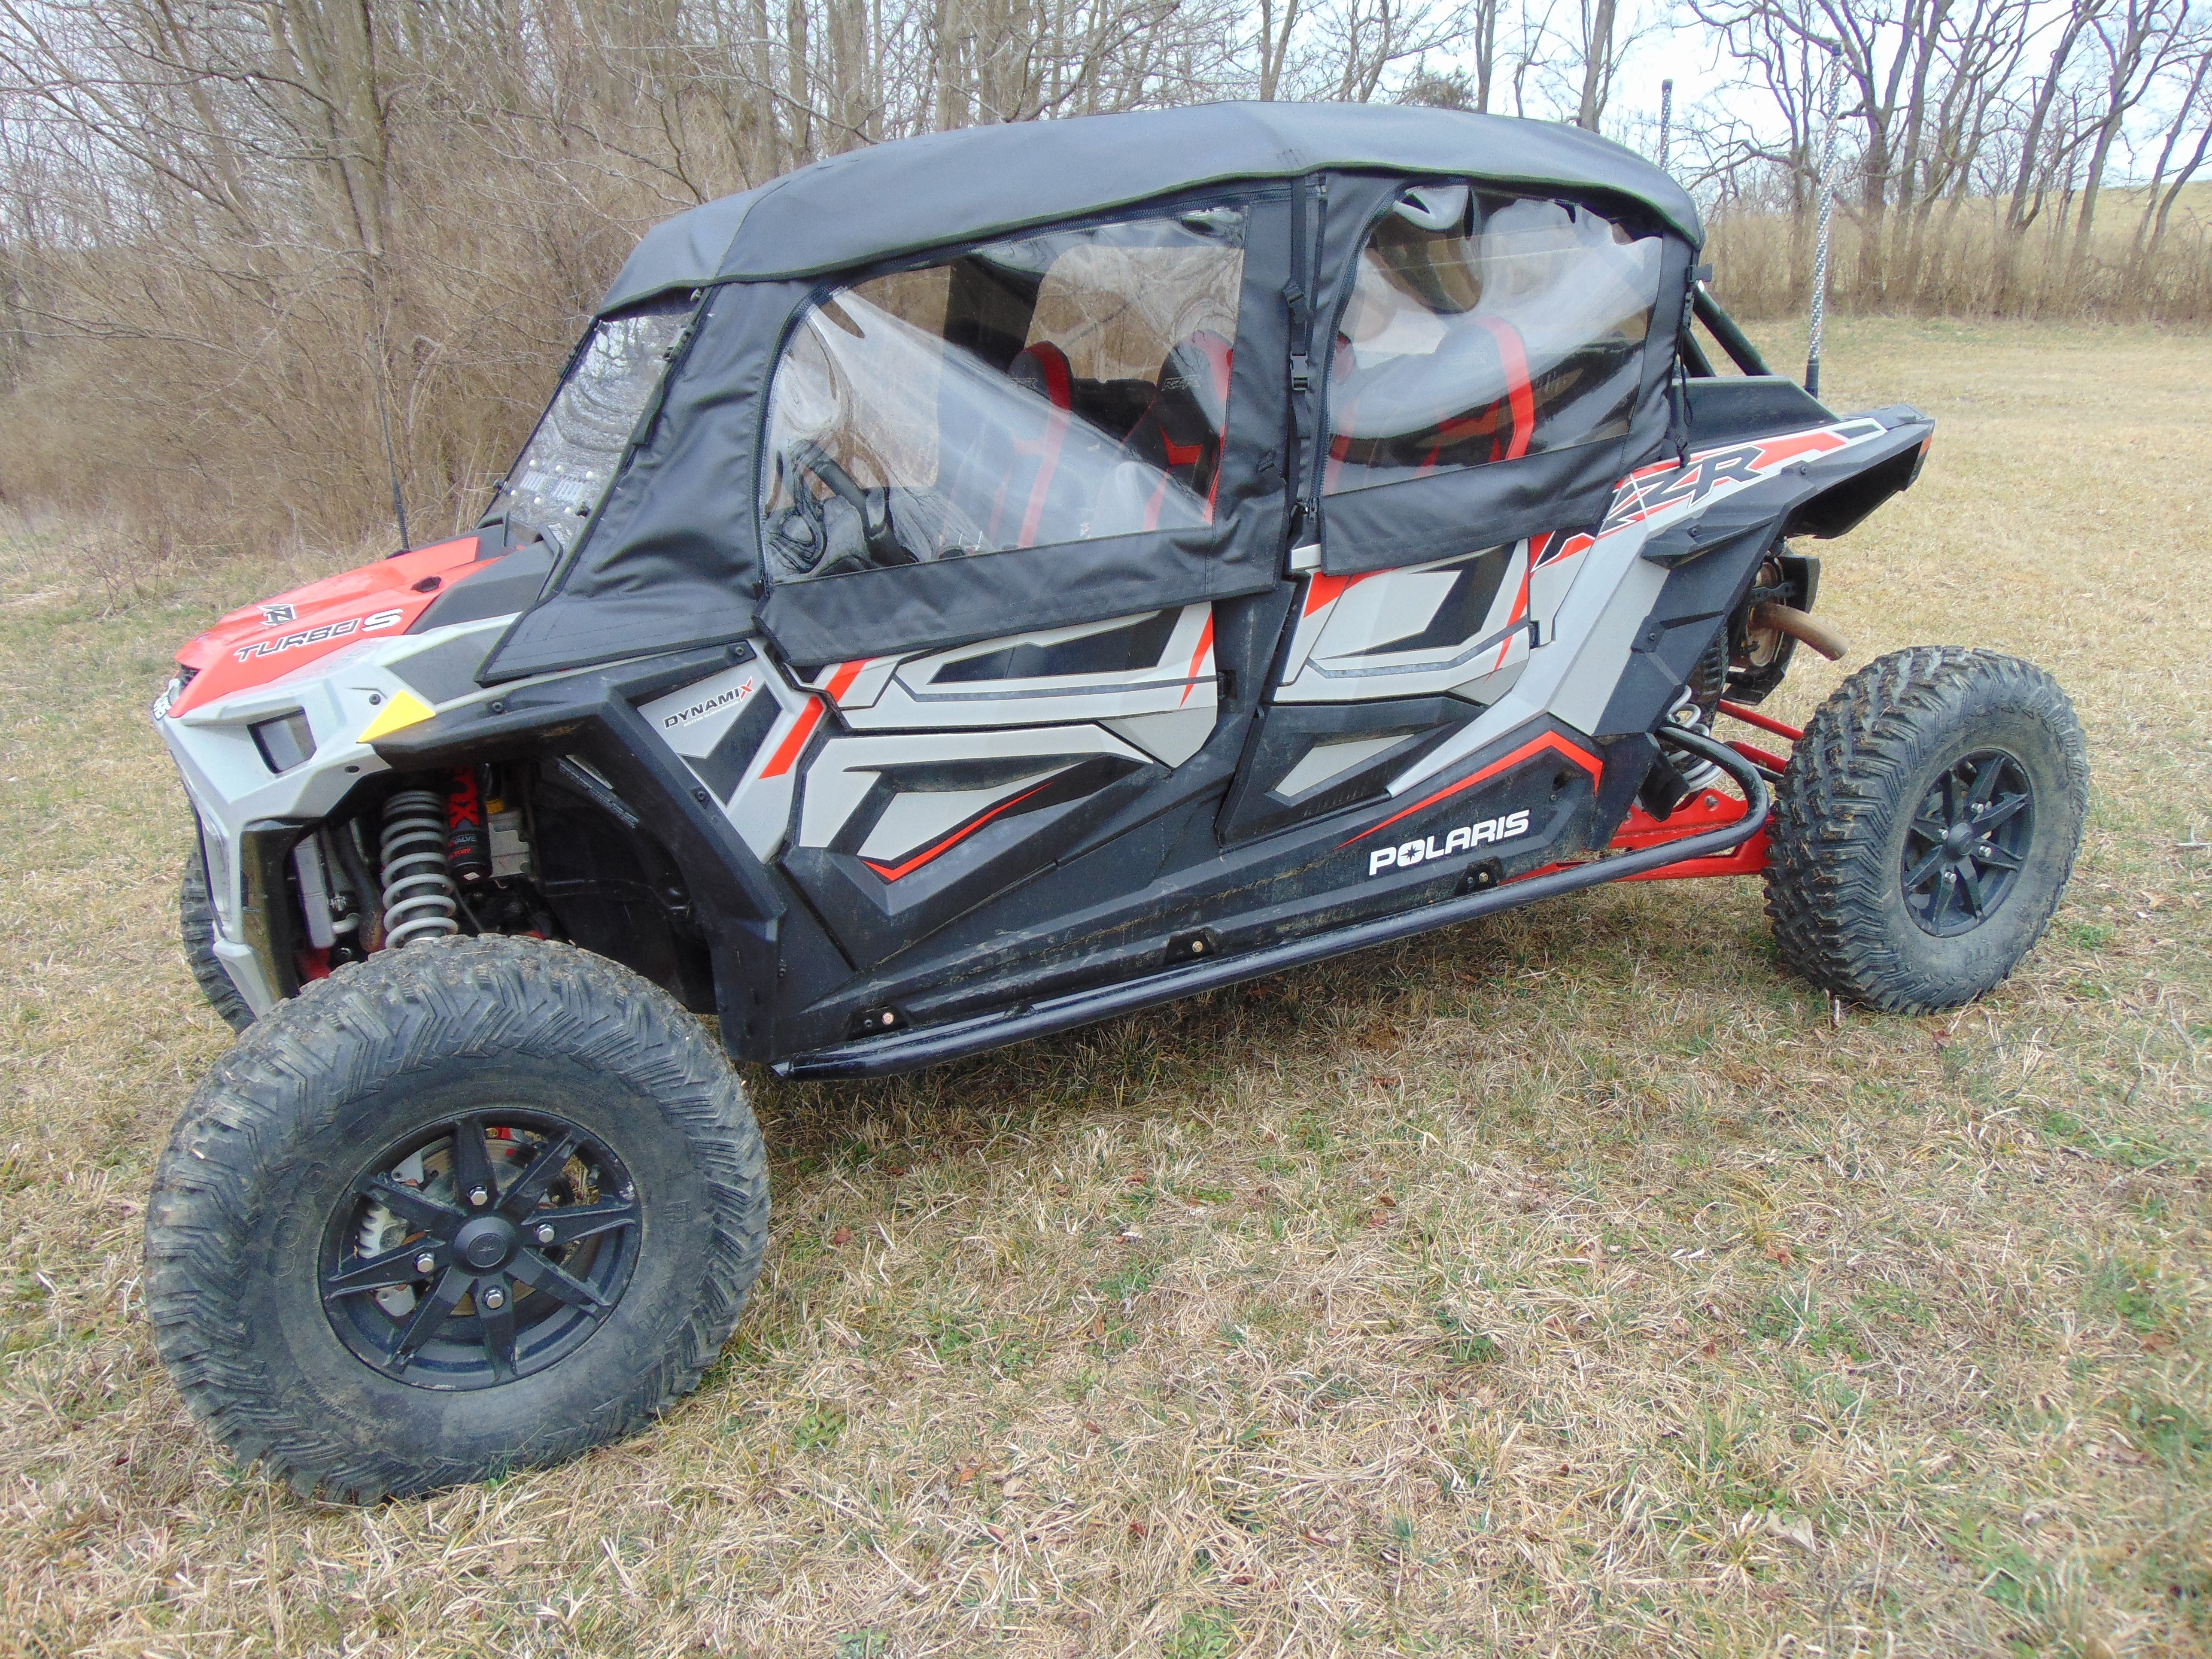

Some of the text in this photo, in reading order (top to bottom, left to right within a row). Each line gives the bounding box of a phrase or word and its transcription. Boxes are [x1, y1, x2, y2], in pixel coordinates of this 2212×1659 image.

[234, 608, 404, 662] TURBO S
[663, 675, 754, 729] DYNAMIX
[684, 717, 703, 727] ACTIVE
[1369, 809, 1530, 876] POLARIS
